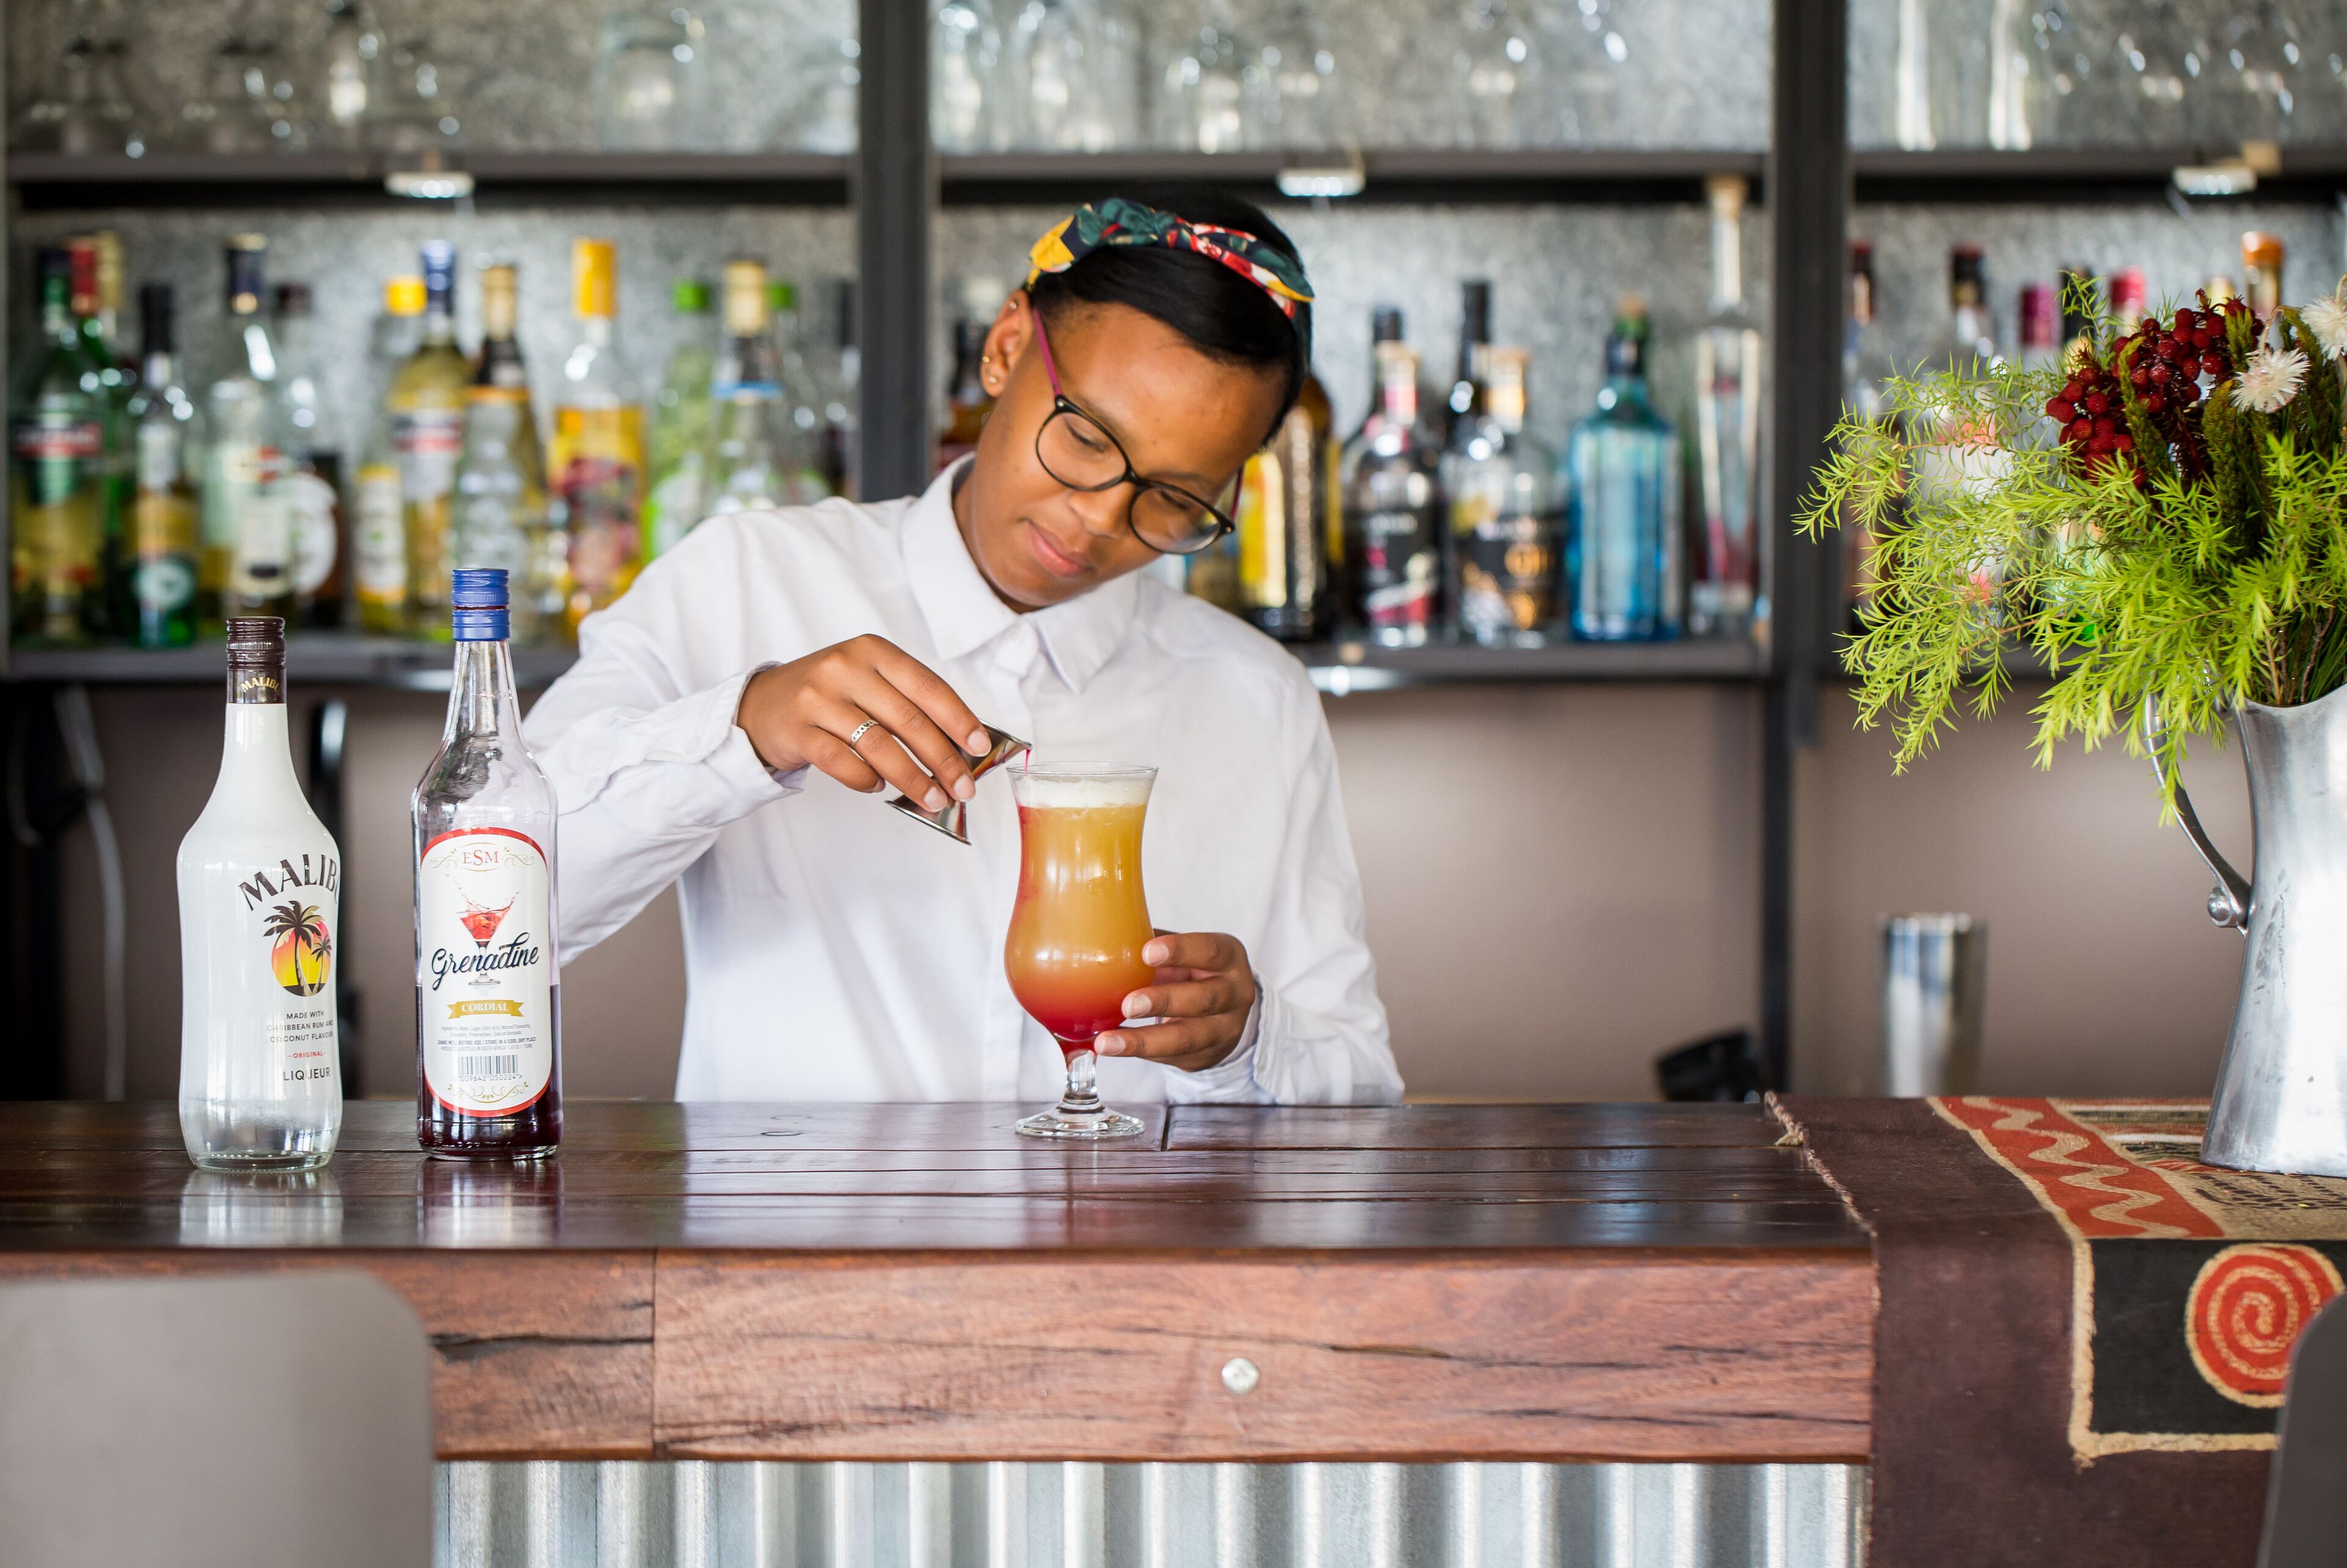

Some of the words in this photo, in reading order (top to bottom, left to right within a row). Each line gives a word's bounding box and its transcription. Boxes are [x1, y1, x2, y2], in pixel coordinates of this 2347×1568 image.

[463, 849, 499, 866] ESM
[432, 932, 539, 991] Grenadine
[461, 1002, 509, 1013] CORDIAL
[266, 1023, 310, 1031] CARIBBEAN
[270, 1034, 310, 1042] COCONUT
[312, 1031, 333, 1040] FLAVOUR
[283, 1067, 331, 1081] LIQUEUR
